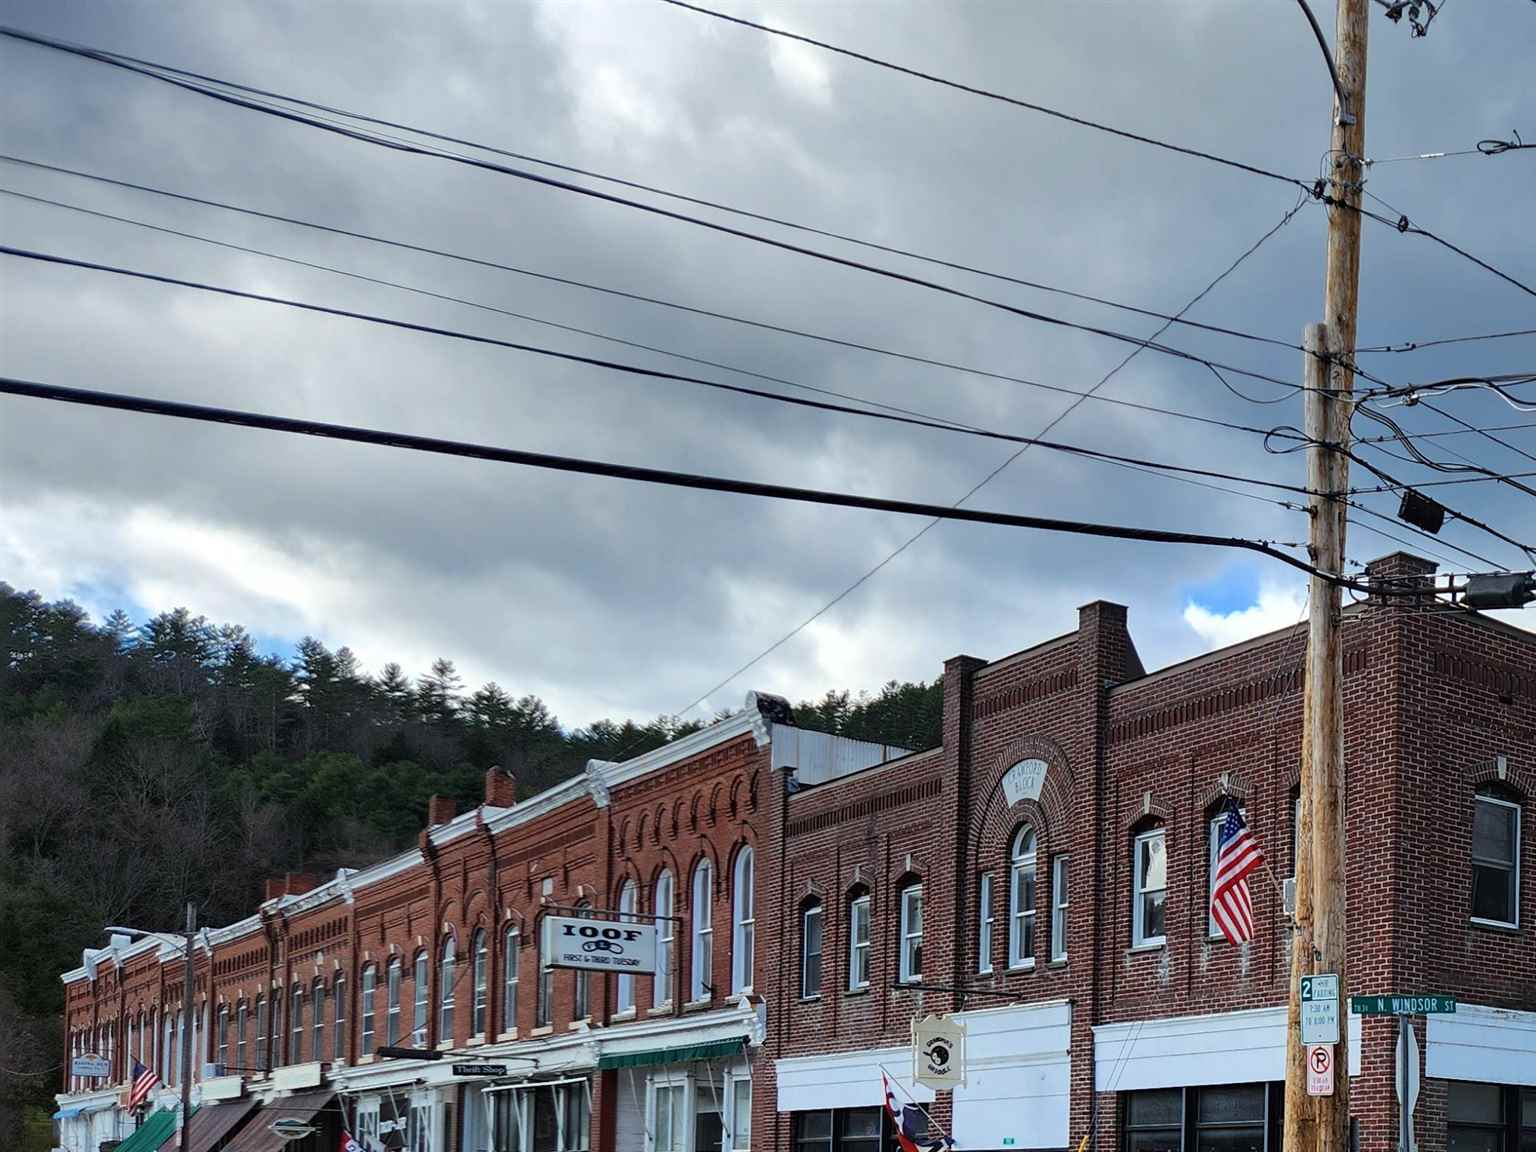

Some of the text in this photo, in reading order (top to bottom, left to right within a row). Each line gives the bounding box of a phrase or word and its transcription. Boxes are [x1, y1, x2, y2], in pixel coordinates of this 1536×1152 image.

[562, 924, 642, 941] IOOF
[1302, 981, 1311, 998] 2
[1377, 998, 1388, 1012] N.
[1391, 998, 1438, 1011] WINDSOR
[1444, 1000, 1454, 1011] ST
[483, 1065, 505, 1075] Shop
